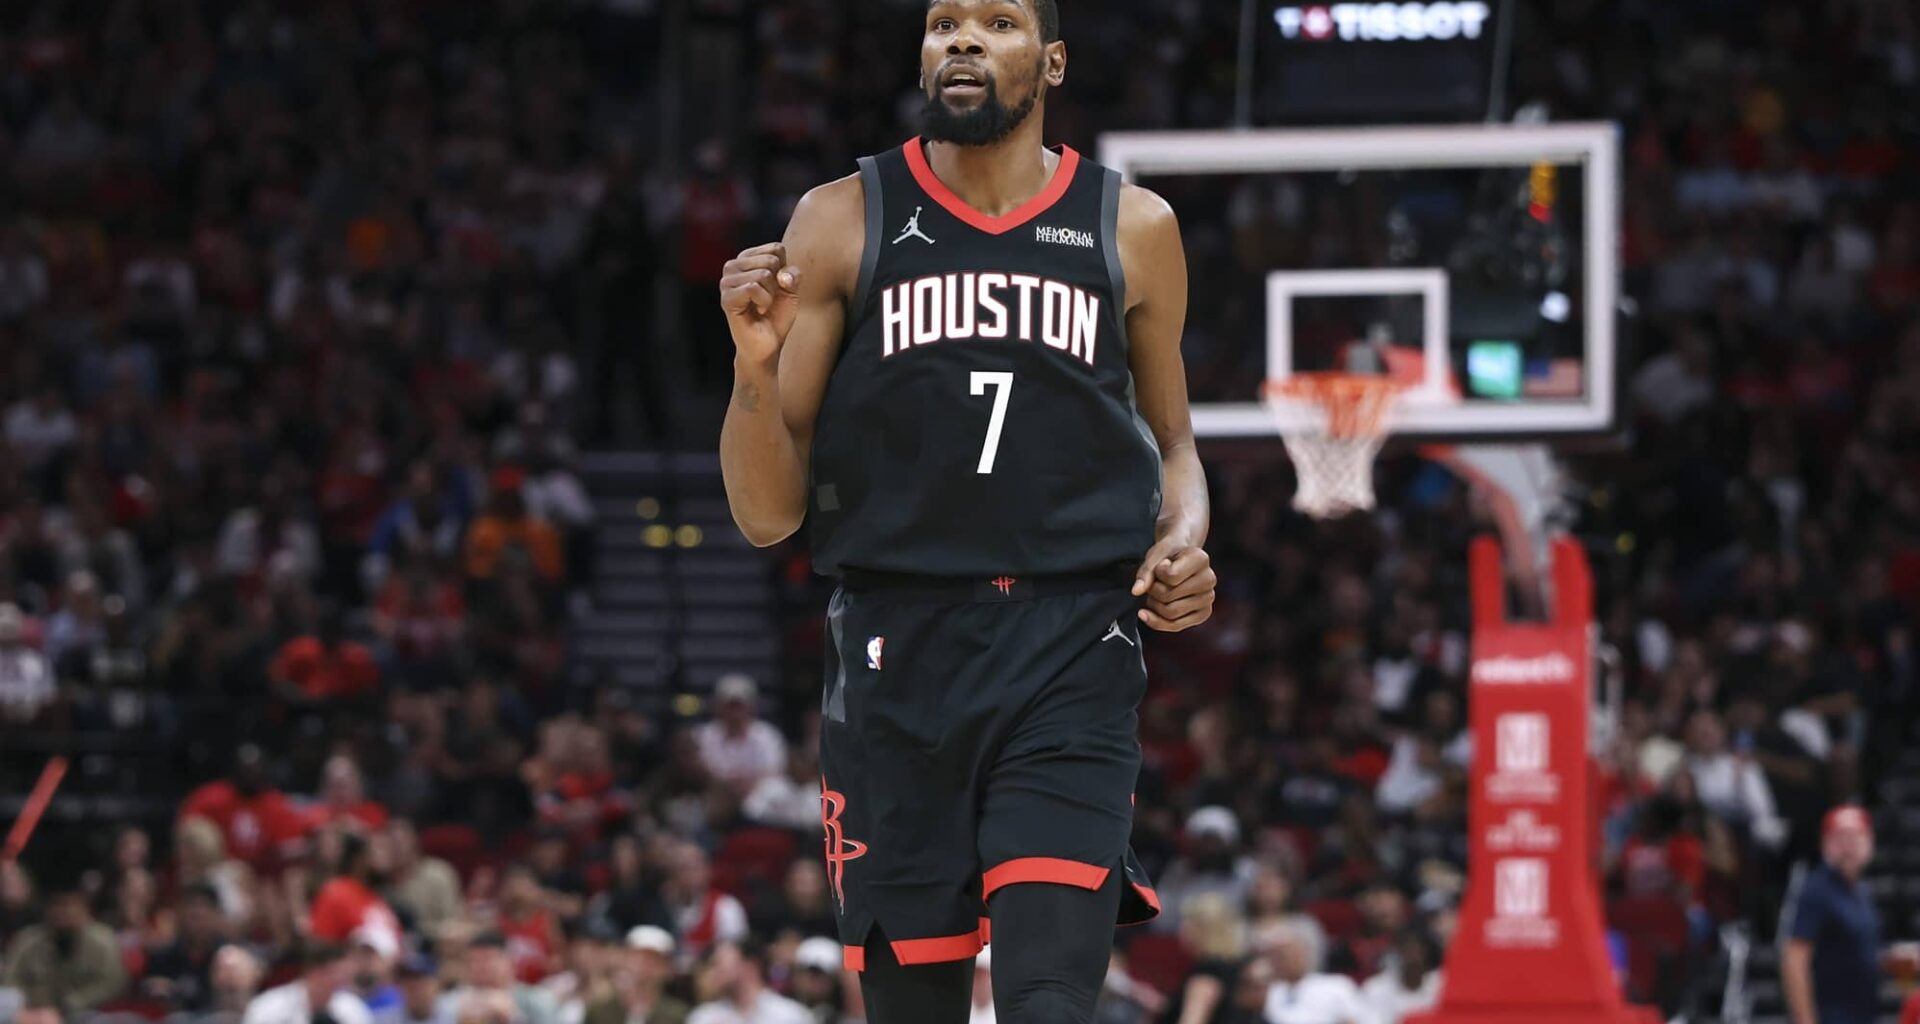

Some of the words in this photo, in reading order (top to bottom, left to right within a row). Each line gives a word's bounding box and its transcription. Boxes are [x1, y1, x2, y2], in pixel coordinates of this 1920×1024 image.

[1331, 2, 1489, 41] TISSOT
[1036, 226, 1092, 241] MEMORIAL
[1036, 233, 1094, 248] HERMANN
[882, 272, 1099, 367] HOUSTON
[969, 371, 1014, 474] 7
